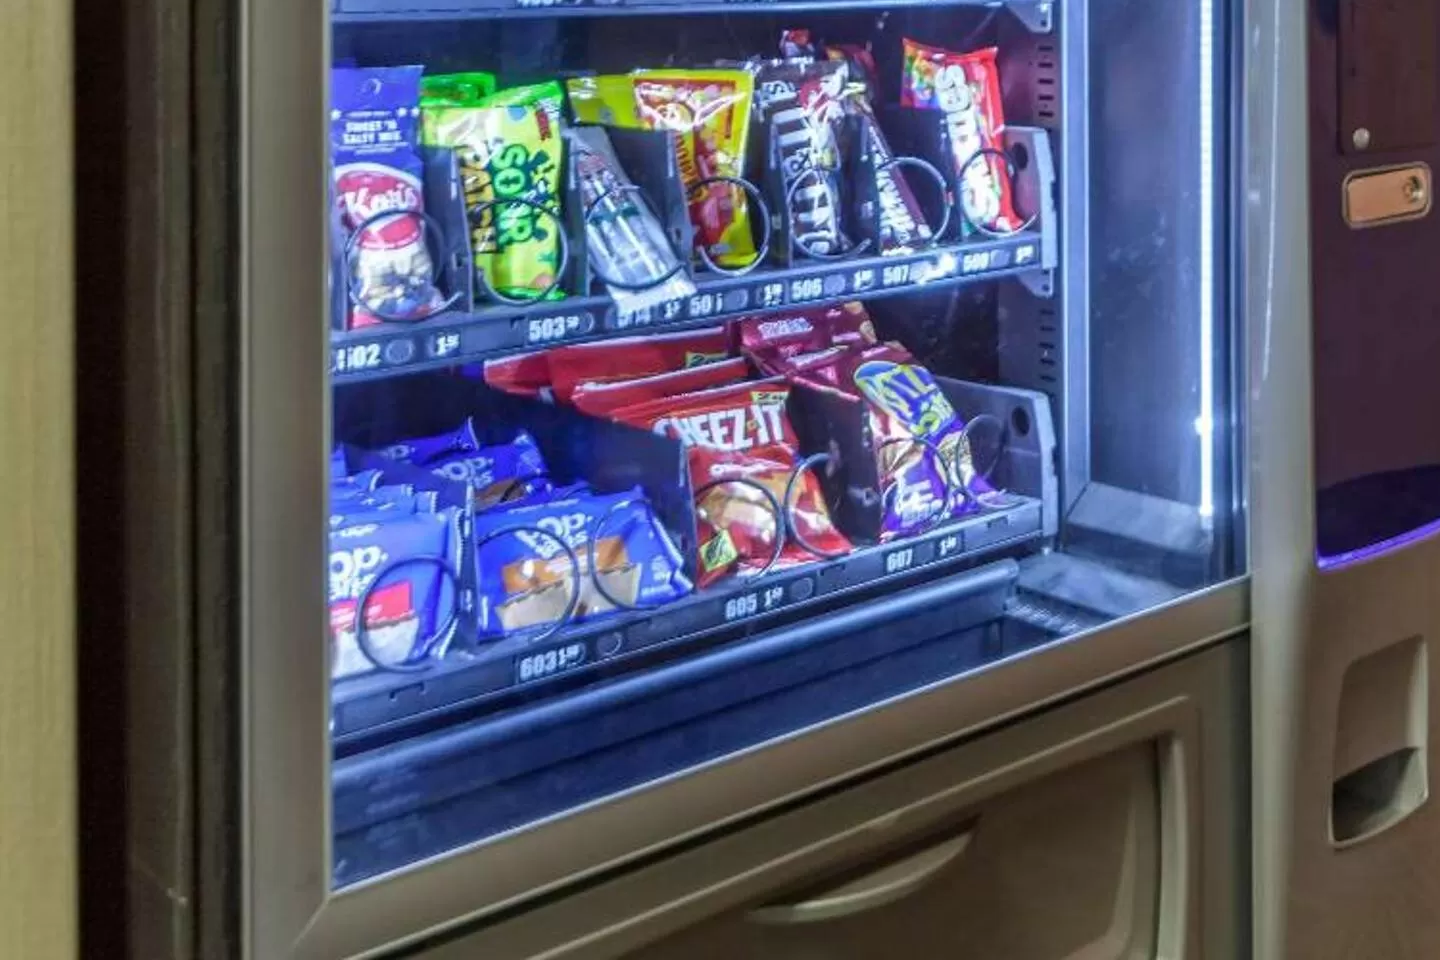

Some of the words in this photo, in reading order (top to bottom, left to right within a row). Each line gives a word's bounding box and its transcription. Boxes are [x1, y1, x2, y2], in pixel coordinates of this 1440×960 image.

[791, 278, 822, 301] 506
[529, 316, 564, 341] 503
[886, 548, 913, 573] 607
[725, 595, 758, 621] 605
[520, 650, 557, 681] 603
